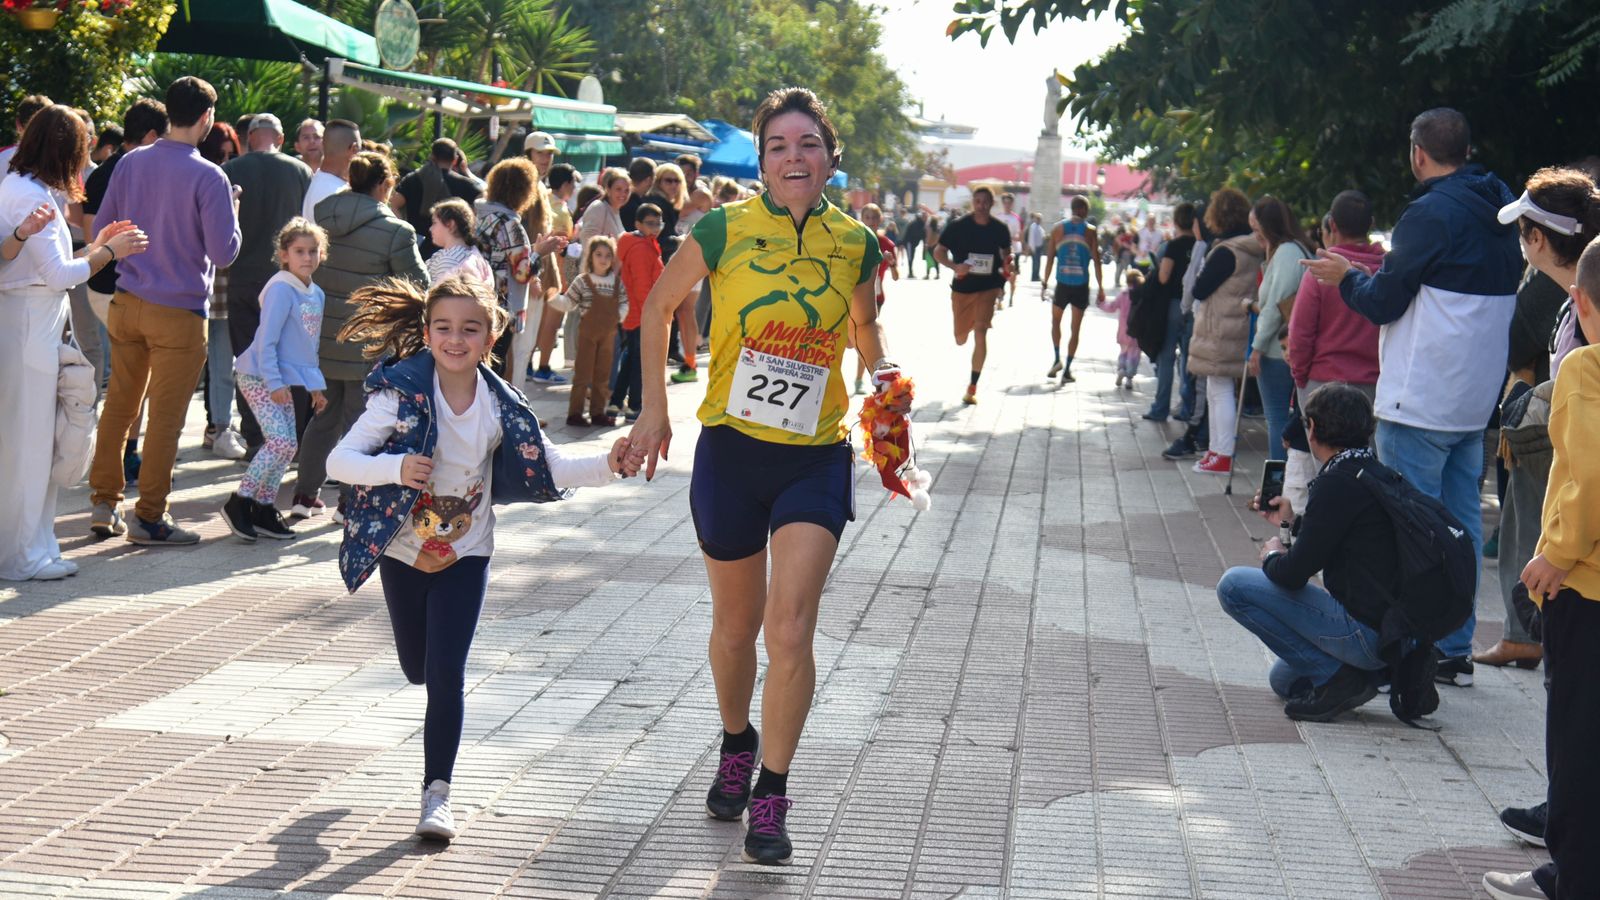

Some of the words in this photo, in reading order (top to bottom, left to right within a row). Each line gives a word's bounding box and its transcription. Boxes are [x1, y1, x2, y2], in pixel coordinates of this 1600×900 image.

[757, 320, 840, 351] Mujeres
[765, 356, 785, 368] SAN
[786, 361, 825, 377] SILVESTRE
[767, 365, 799, 378] TARIFEÑA
[800, 373, 815, 381] 2023
[747, 374, 810, 410] 227
